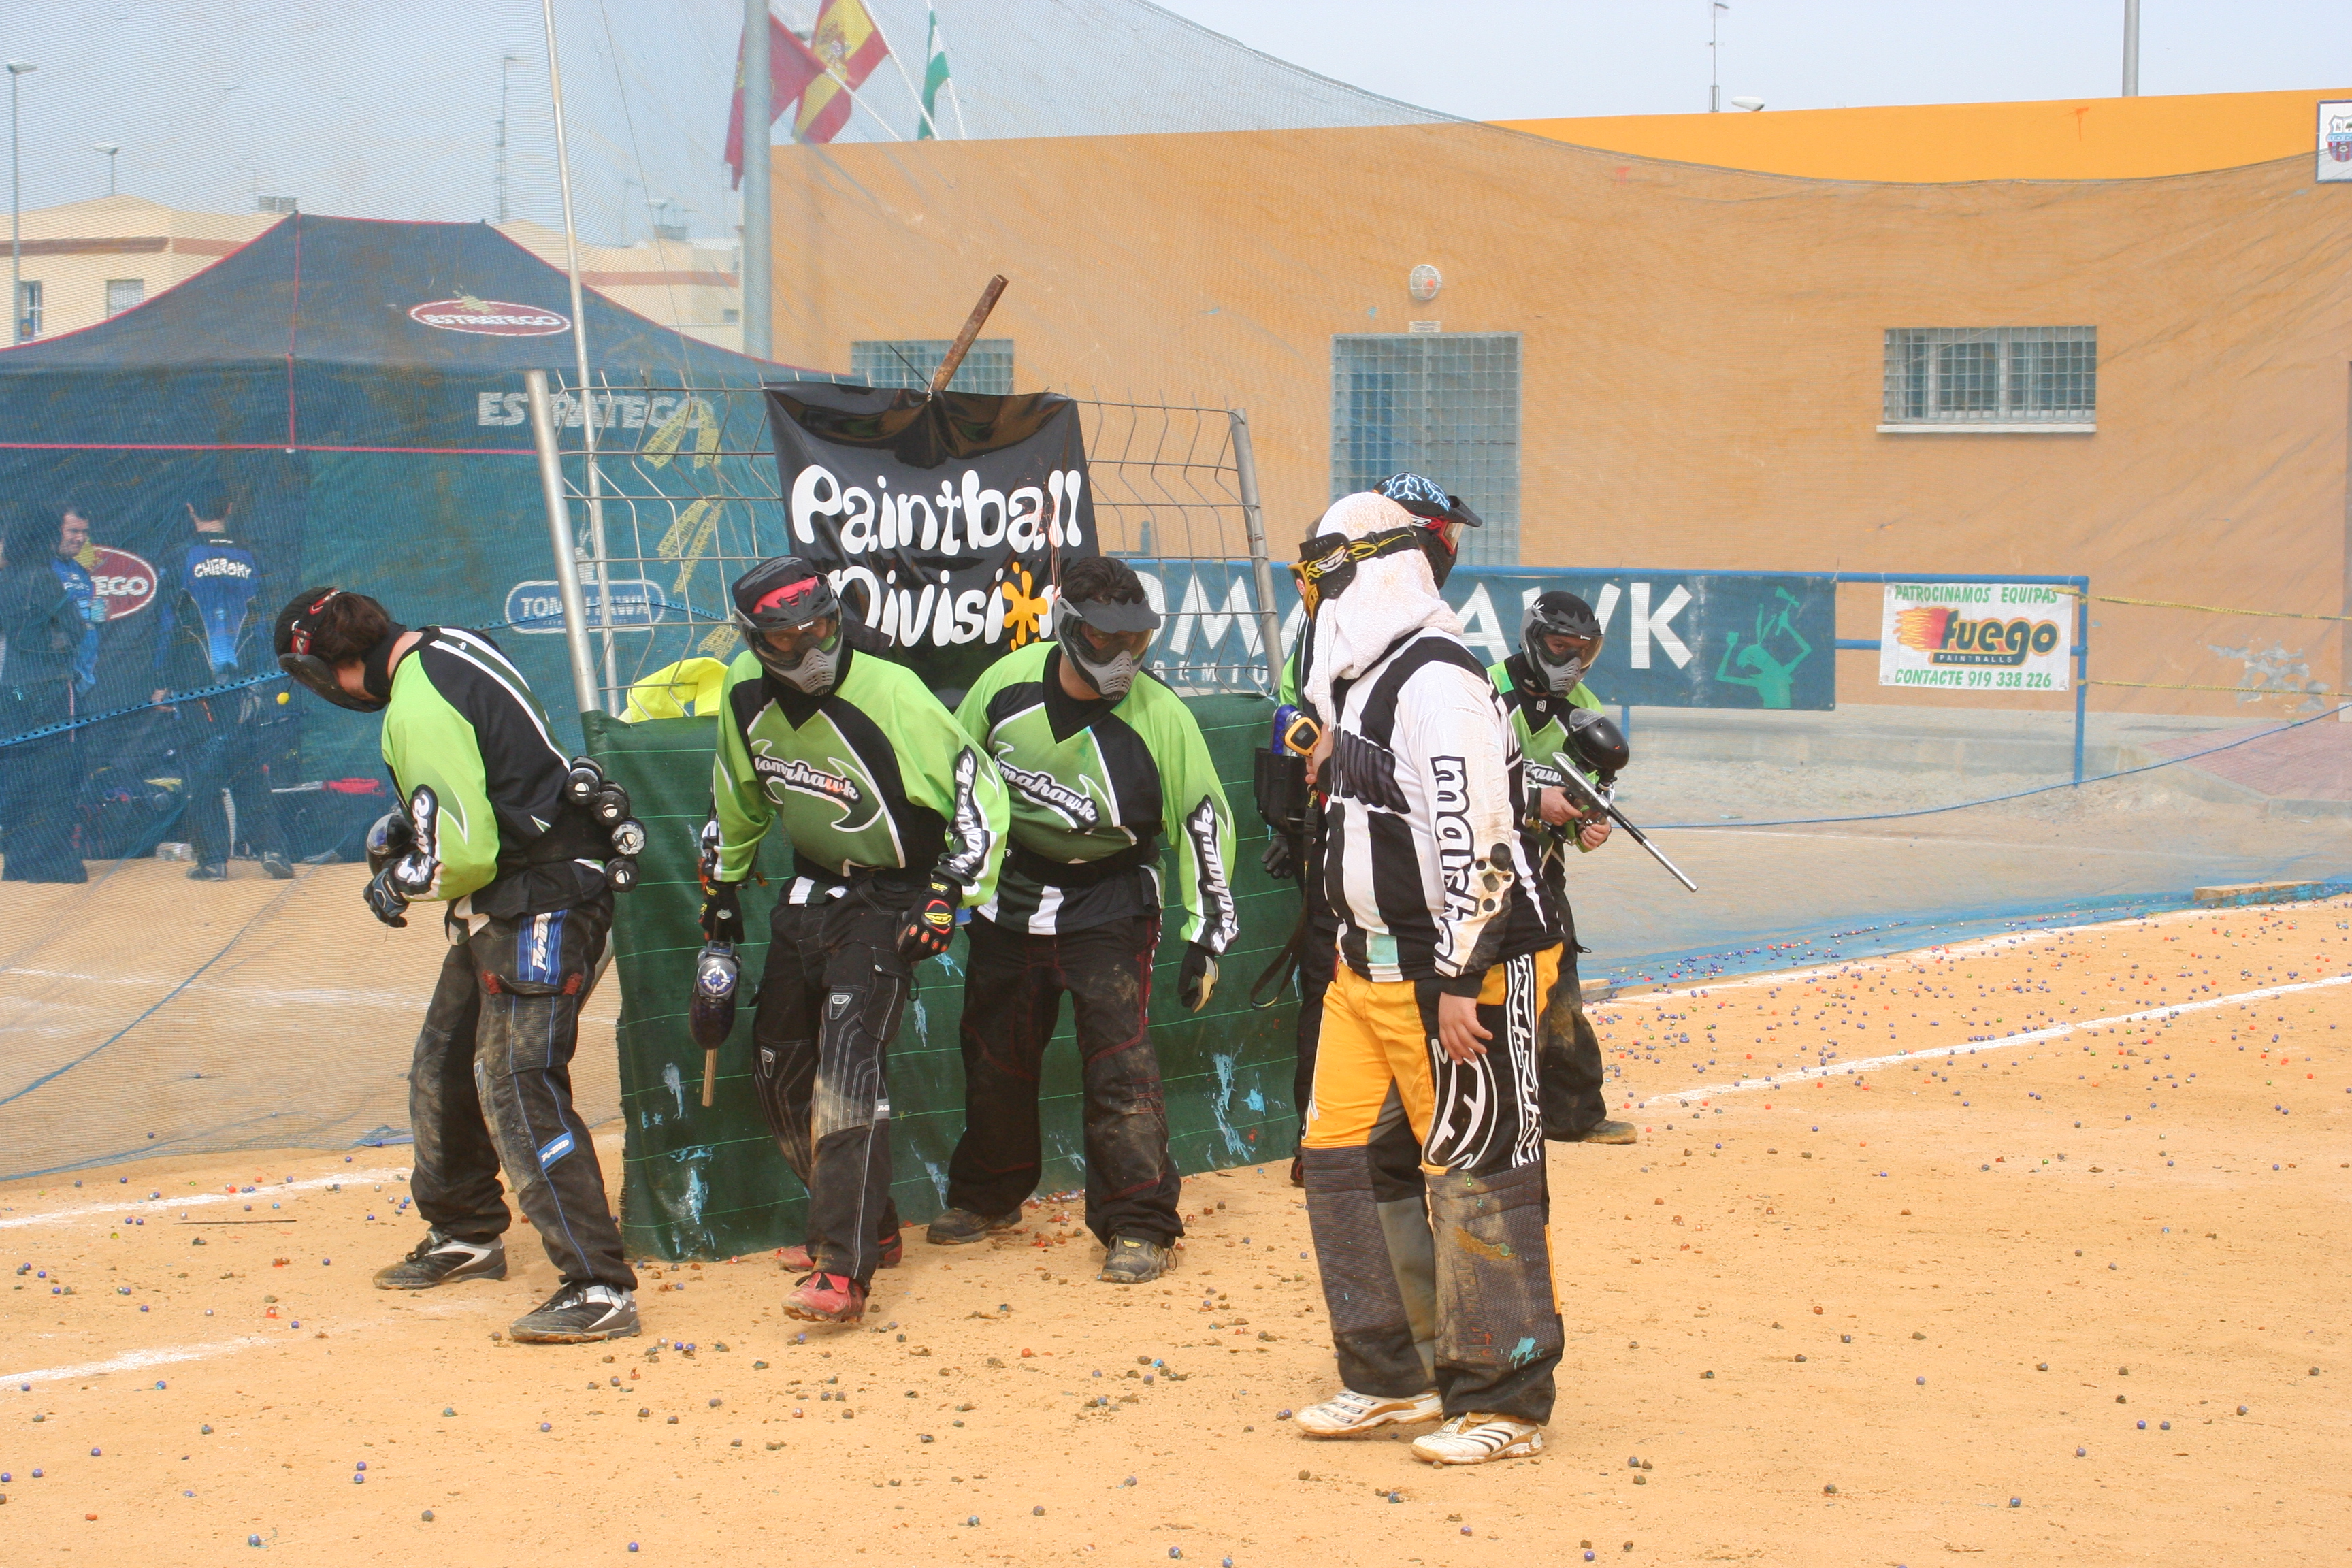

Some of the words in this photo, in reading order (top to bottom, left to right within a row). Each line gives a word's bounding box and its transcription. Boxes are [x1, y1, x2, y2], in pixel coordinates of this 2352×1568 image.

[478, 391, 716, 429] ESRATEGO
[791, 464, 1082, 556] Paintball
[1895, 585, 1991, 604] PATROCINAMOS
[1940, 653, 2012, 664] PAINTBALLS
[1895, 669, 1963, 685] CONTACTE
[1968, 670, 1991, 687] 919
[1996, 672, 2021, 687] 338
[2026, 672, 2052, 688] 226
[994, 758, 1096, 821] omahawk
